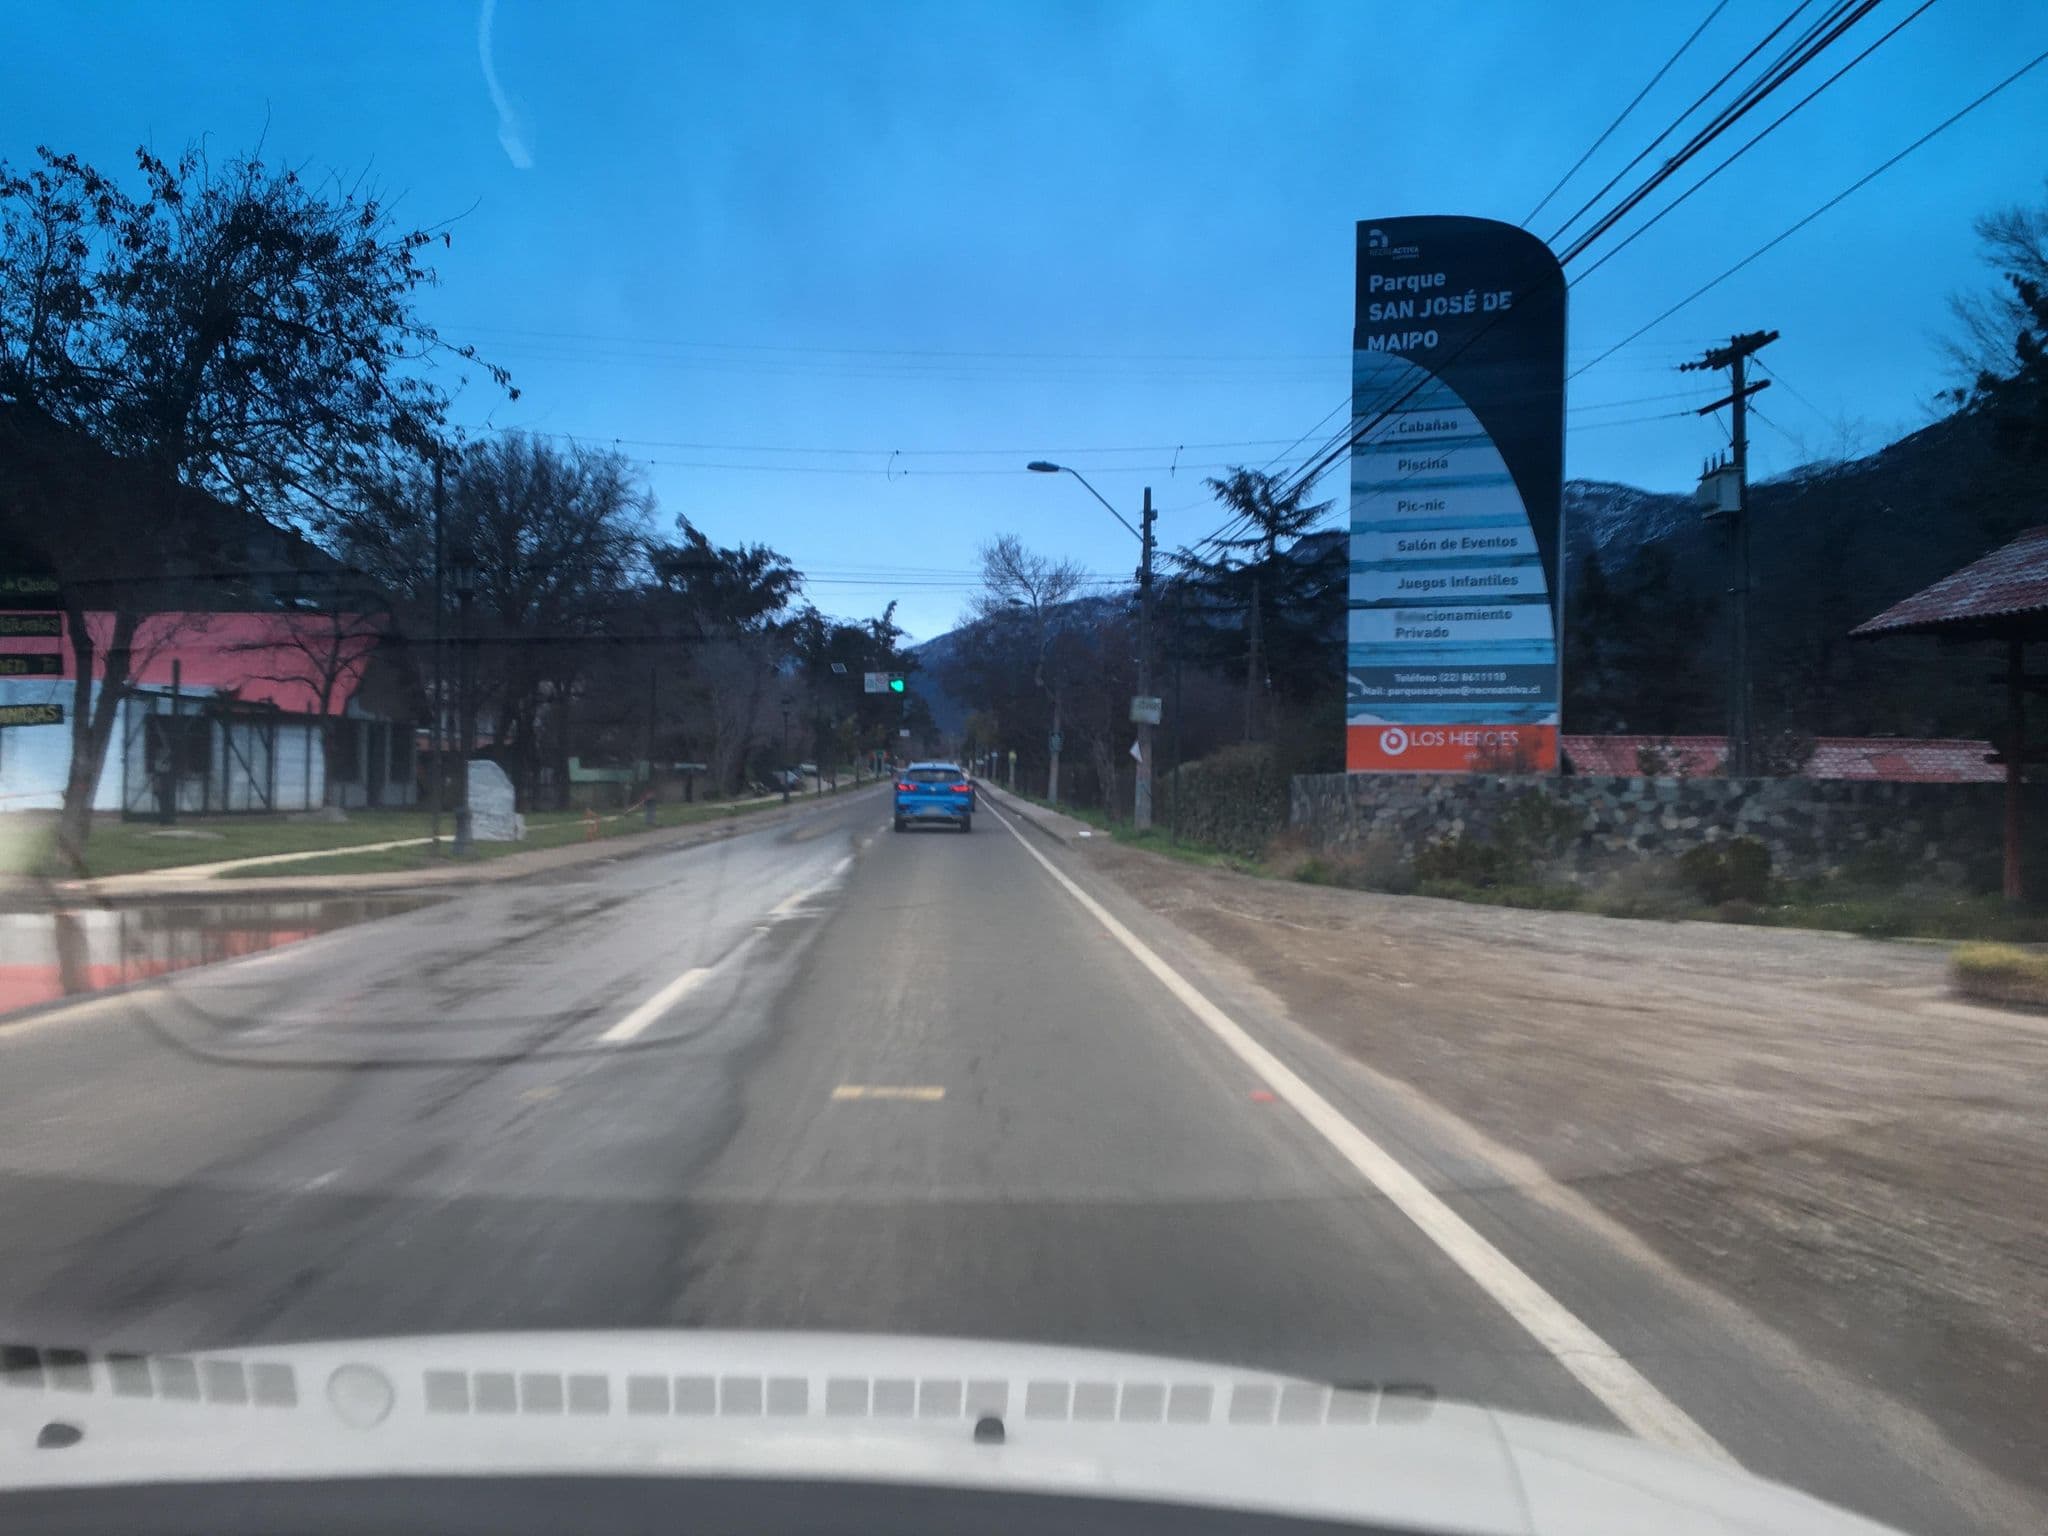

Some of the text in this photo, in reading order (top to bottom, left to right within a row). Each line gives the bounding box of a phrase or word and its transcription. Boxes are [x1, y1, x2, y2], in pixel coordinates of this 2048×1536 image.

[1369, 272, 1446, 293] Parque
[1369, 289, 1512, 321] SAN JOSÉ DE
[1367, 330, 1438, 352] MAIPO
[1400, 419, 1458, 434] Cabañas
[1398, 457, 1448, 471] Piscina
[1397, 500, 1445, 513] Pic-nic
[1398, 536, 1518, 552] Salón de Eventos
[1398, 574, 1519, 591] Juegos Infantiles
[1395, 609, 1512, 623] Ecionamiento
[1395, 626, 1449, 639] Privado
[1411, 732, 1444, 747] LOS
